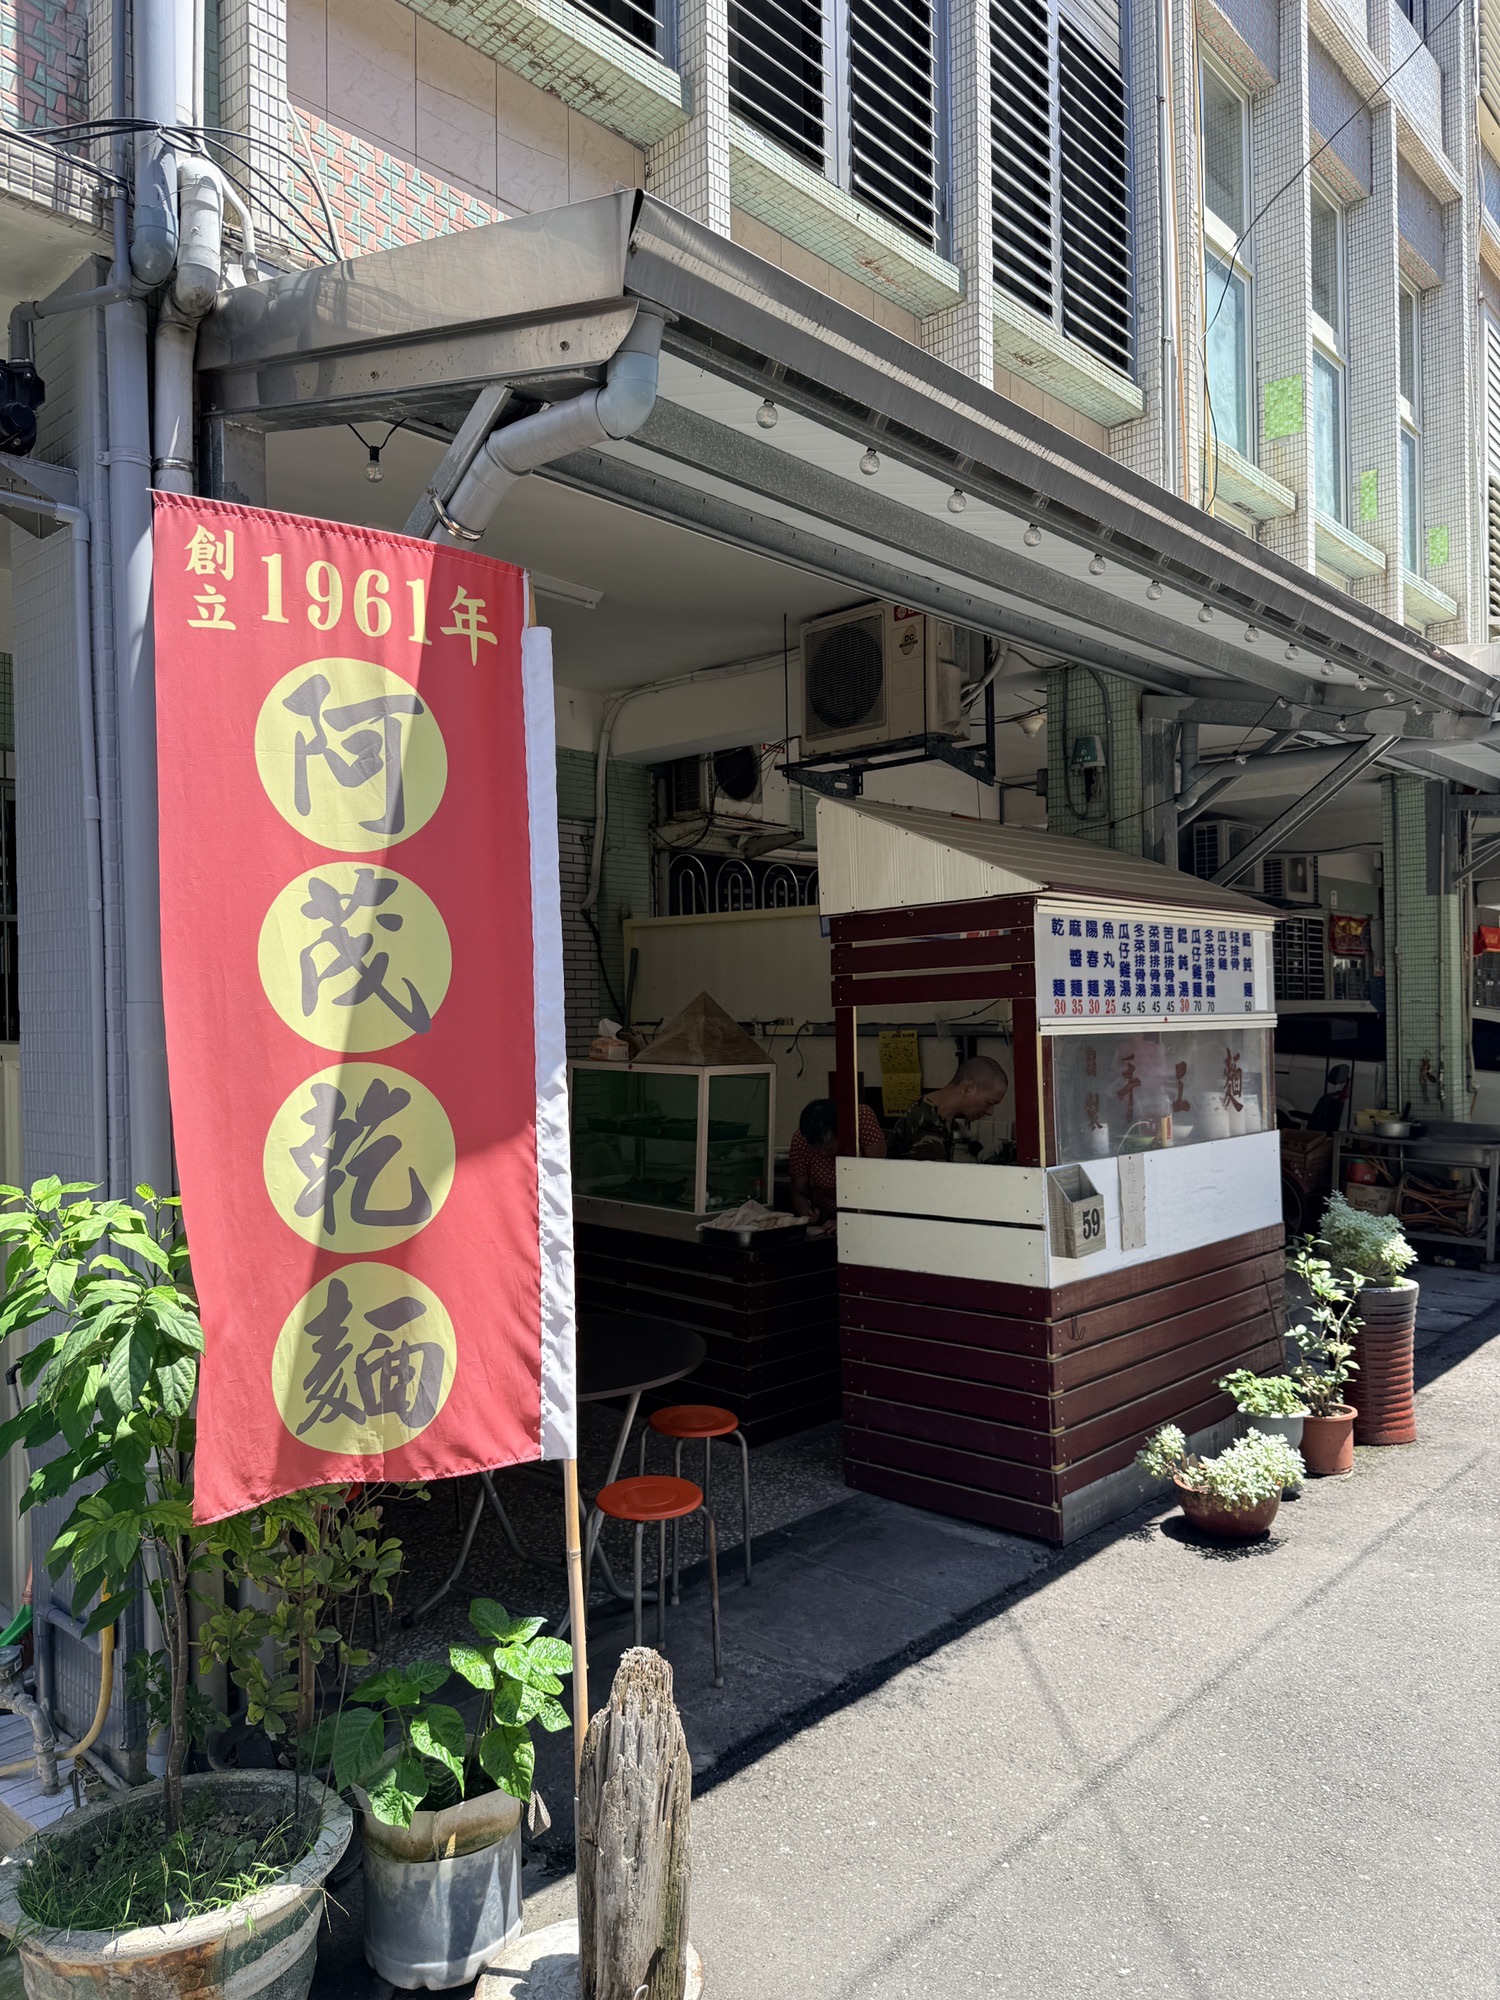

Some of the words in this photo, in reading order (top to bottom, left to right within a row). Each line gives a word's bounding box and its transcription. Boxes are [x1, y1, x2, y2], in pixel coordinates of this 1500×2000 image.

[1051, 917, 1066, 997] 乾麵
[1068, 919, 1083, 997] 麻醬麵
[1085, 920, 1100, 997] 陽春麵
[1102, 921, 1116, 997] 魚丸湯
[1118, 923, 1131, 997] 瓜仔雞湯
[1133, 924, 1146, 997] 冬菜排骨湯
[1148, 925, 1161, 997] 菜頭排骨湯
[1163, 926, 1175, 997] 苦瓜排骨湯
[1177, 927, 1189, 997] 餛飩湯
[1191, 928, 1203, 997] 瓜仔雞麵
[1204, 929, 1216, 998] 冬菜排骨麵
[1217, 930, 1228, 971] 瓜仔雞
[1242, 932, 1253, 997] 餛飩麵
[1054, 998, 1066, 1015] 30
[1072, 998, 1083, 1015] 35
[1088, 998, 1100, 1015] 30
[1105, 999, 1116, 1014] 25
[1121, 1001, 1131, 1014] 45
[1136, 1001, 1146, 1013] 45
[1152, 1000, 1161, 1013] 45
[1166, 1000, 1175, 1013] 45
[1180, 998, 1189, 1013] 30
[1194, 1000, 1202, 1012] 70
[1206, 1001, 1215, 1012] 70
[1244, 1001, 1252, 1012] 60
[282, 674, 444, 1436] 阿茂乾麵
[1116, 1047, 1244, 1123] 手工麵
[1082, 1208, 1101, 1240] 59
